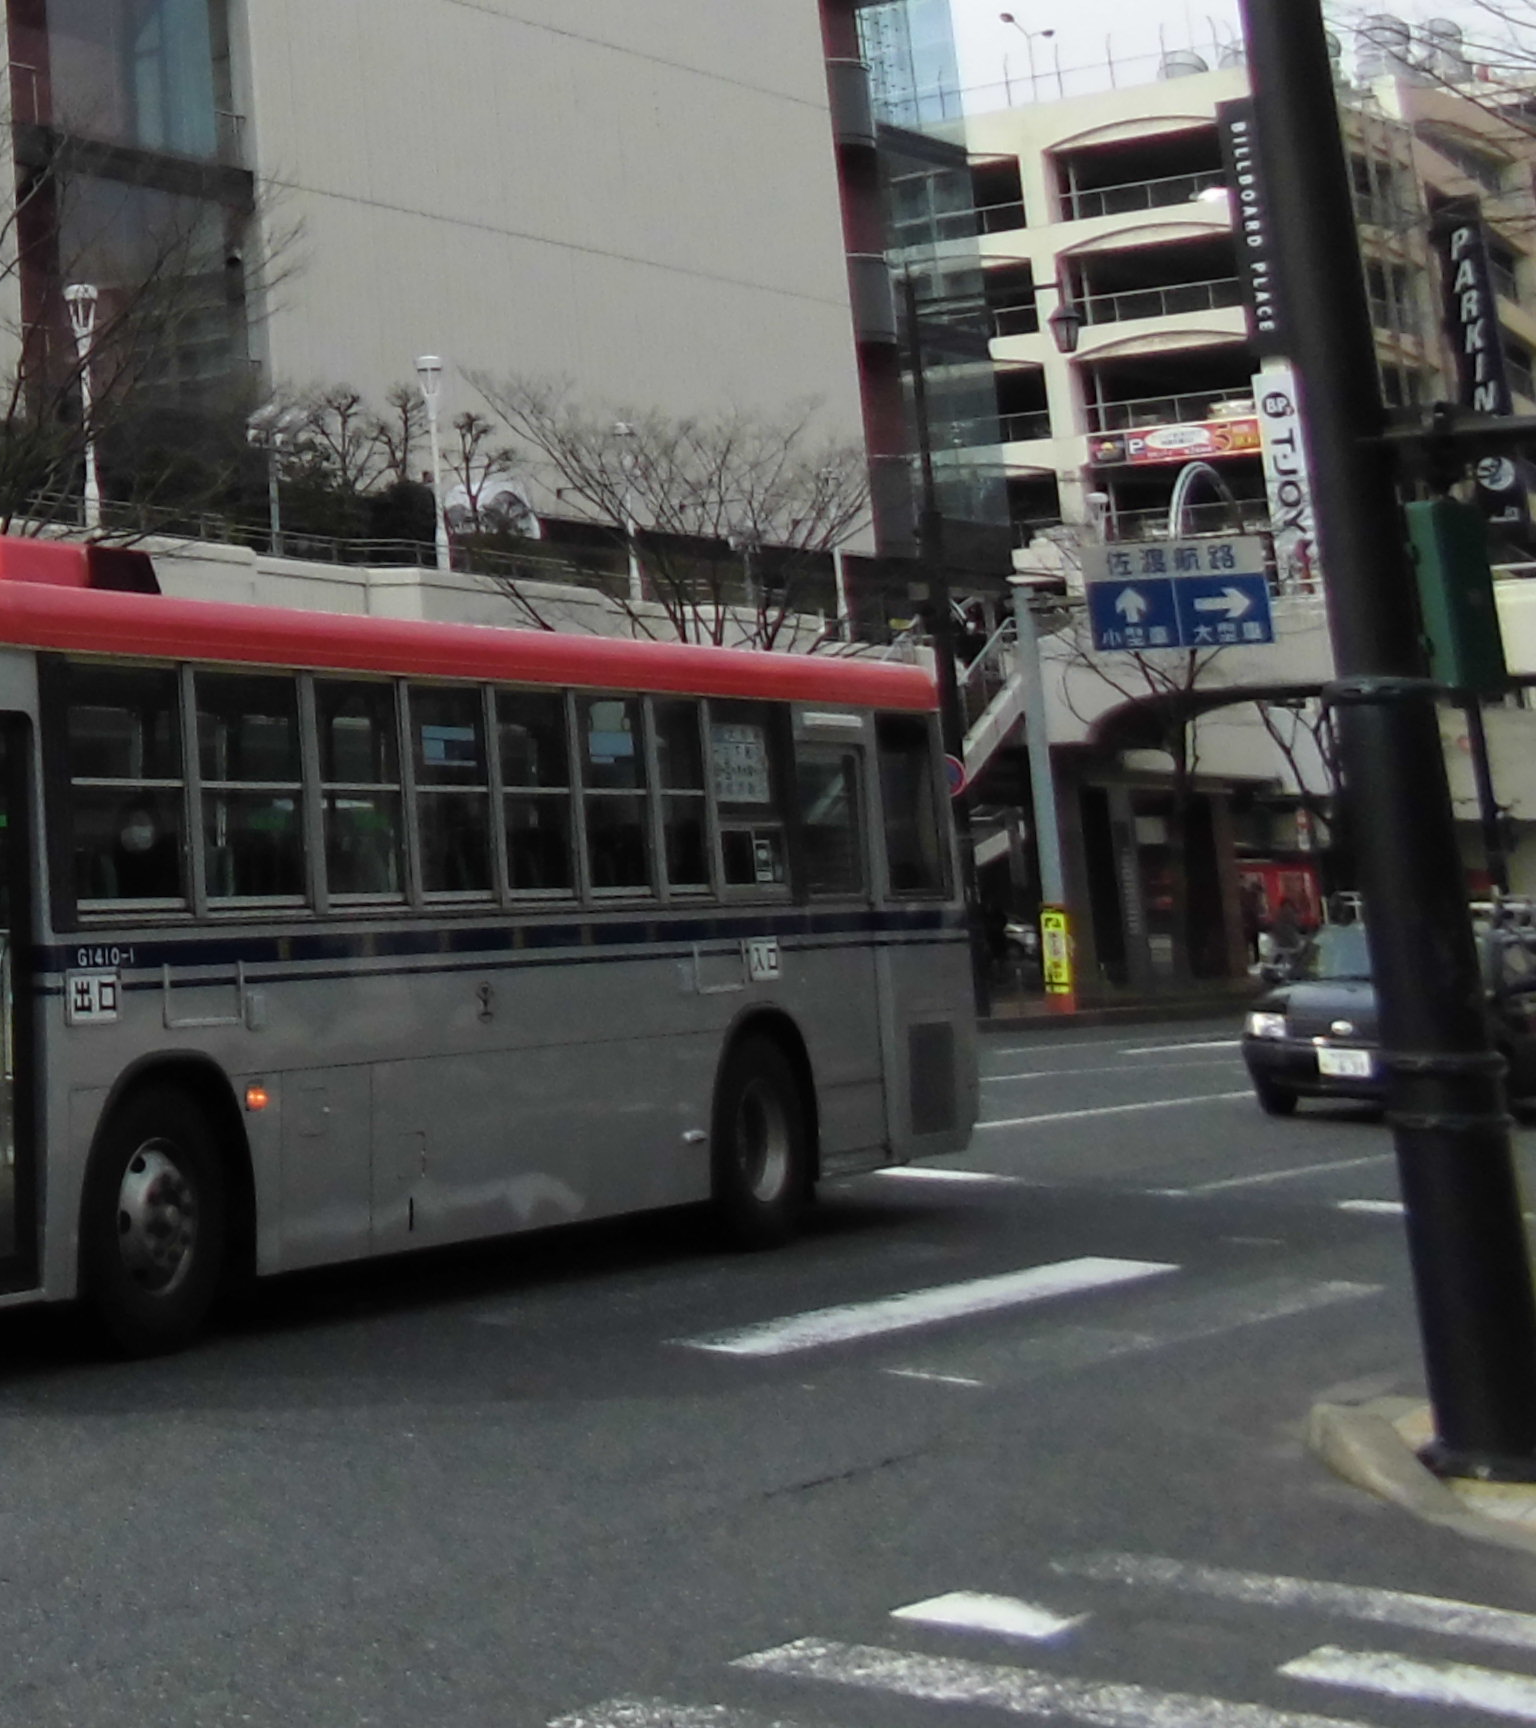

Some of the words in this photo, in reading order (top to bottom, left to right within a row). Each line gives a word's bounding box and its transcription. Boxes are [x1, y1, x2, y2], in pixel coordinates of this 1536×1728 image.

[1230, 121, 1263, 247] BILLBOARD
[1251, 261, 1276, 331] PLACE
[1451, 226, 1498, 414] PARKIN
[1107, 543, 1236, 575] 佐渡航路
[753, 946, 778, 972] 入口
[74, 981, 116, 1012] 出口
